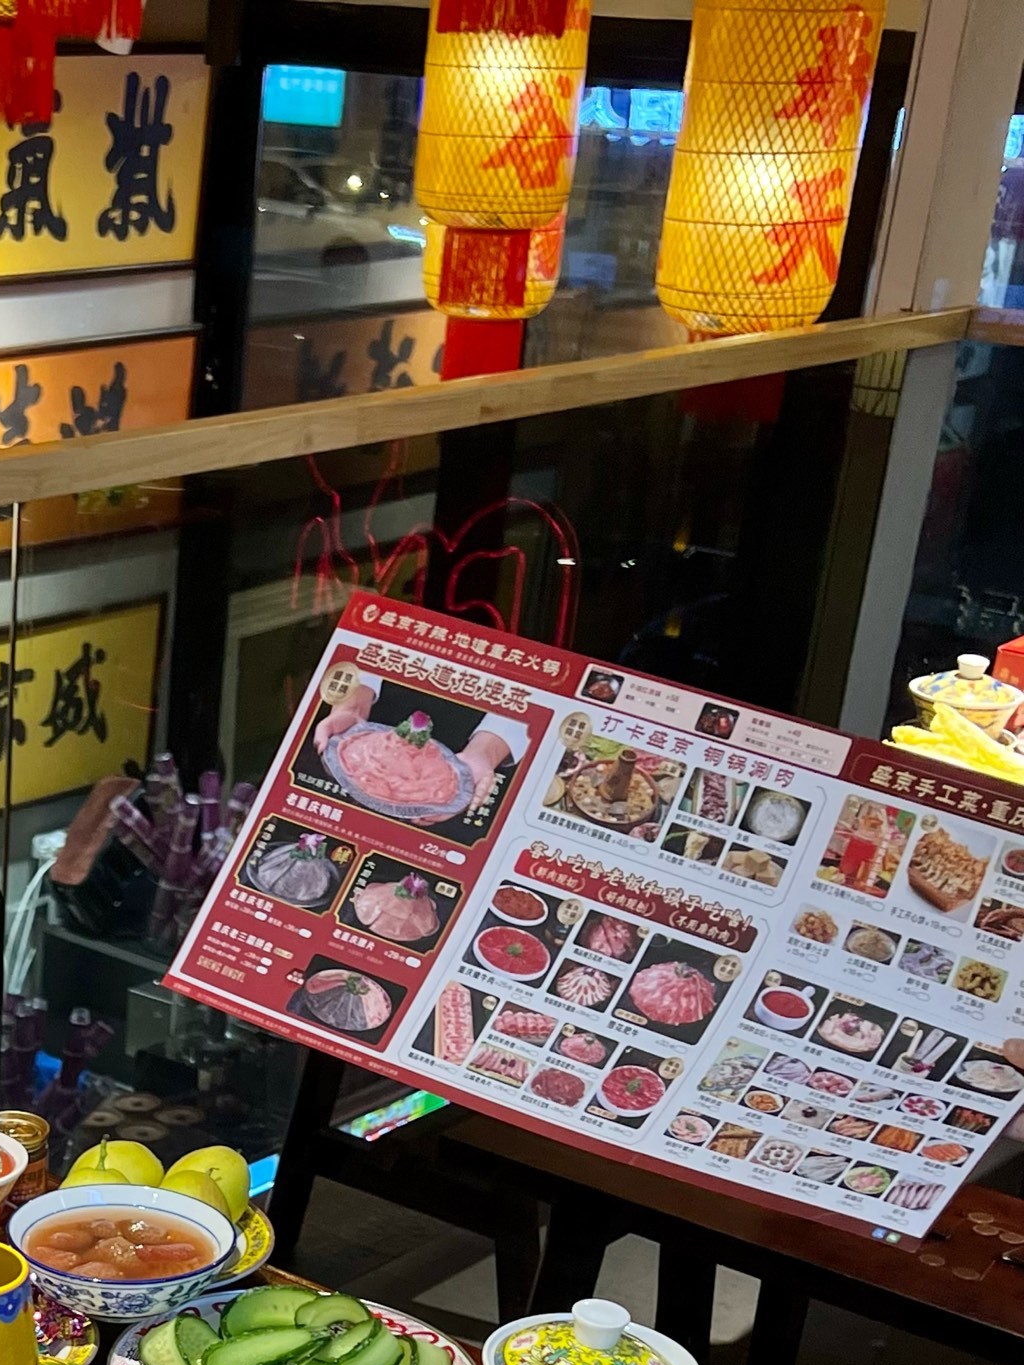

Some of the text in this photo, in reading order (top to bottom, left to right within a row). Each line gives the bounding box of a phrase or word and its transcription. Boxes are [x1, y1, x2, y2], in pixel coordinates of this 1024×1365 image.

[353, 639, 536, 714] 盛京头道招牌菜
[598, 714, 695, 756] 打卡盛京
[697, 745, 796, 788] 铜锅涮肉
